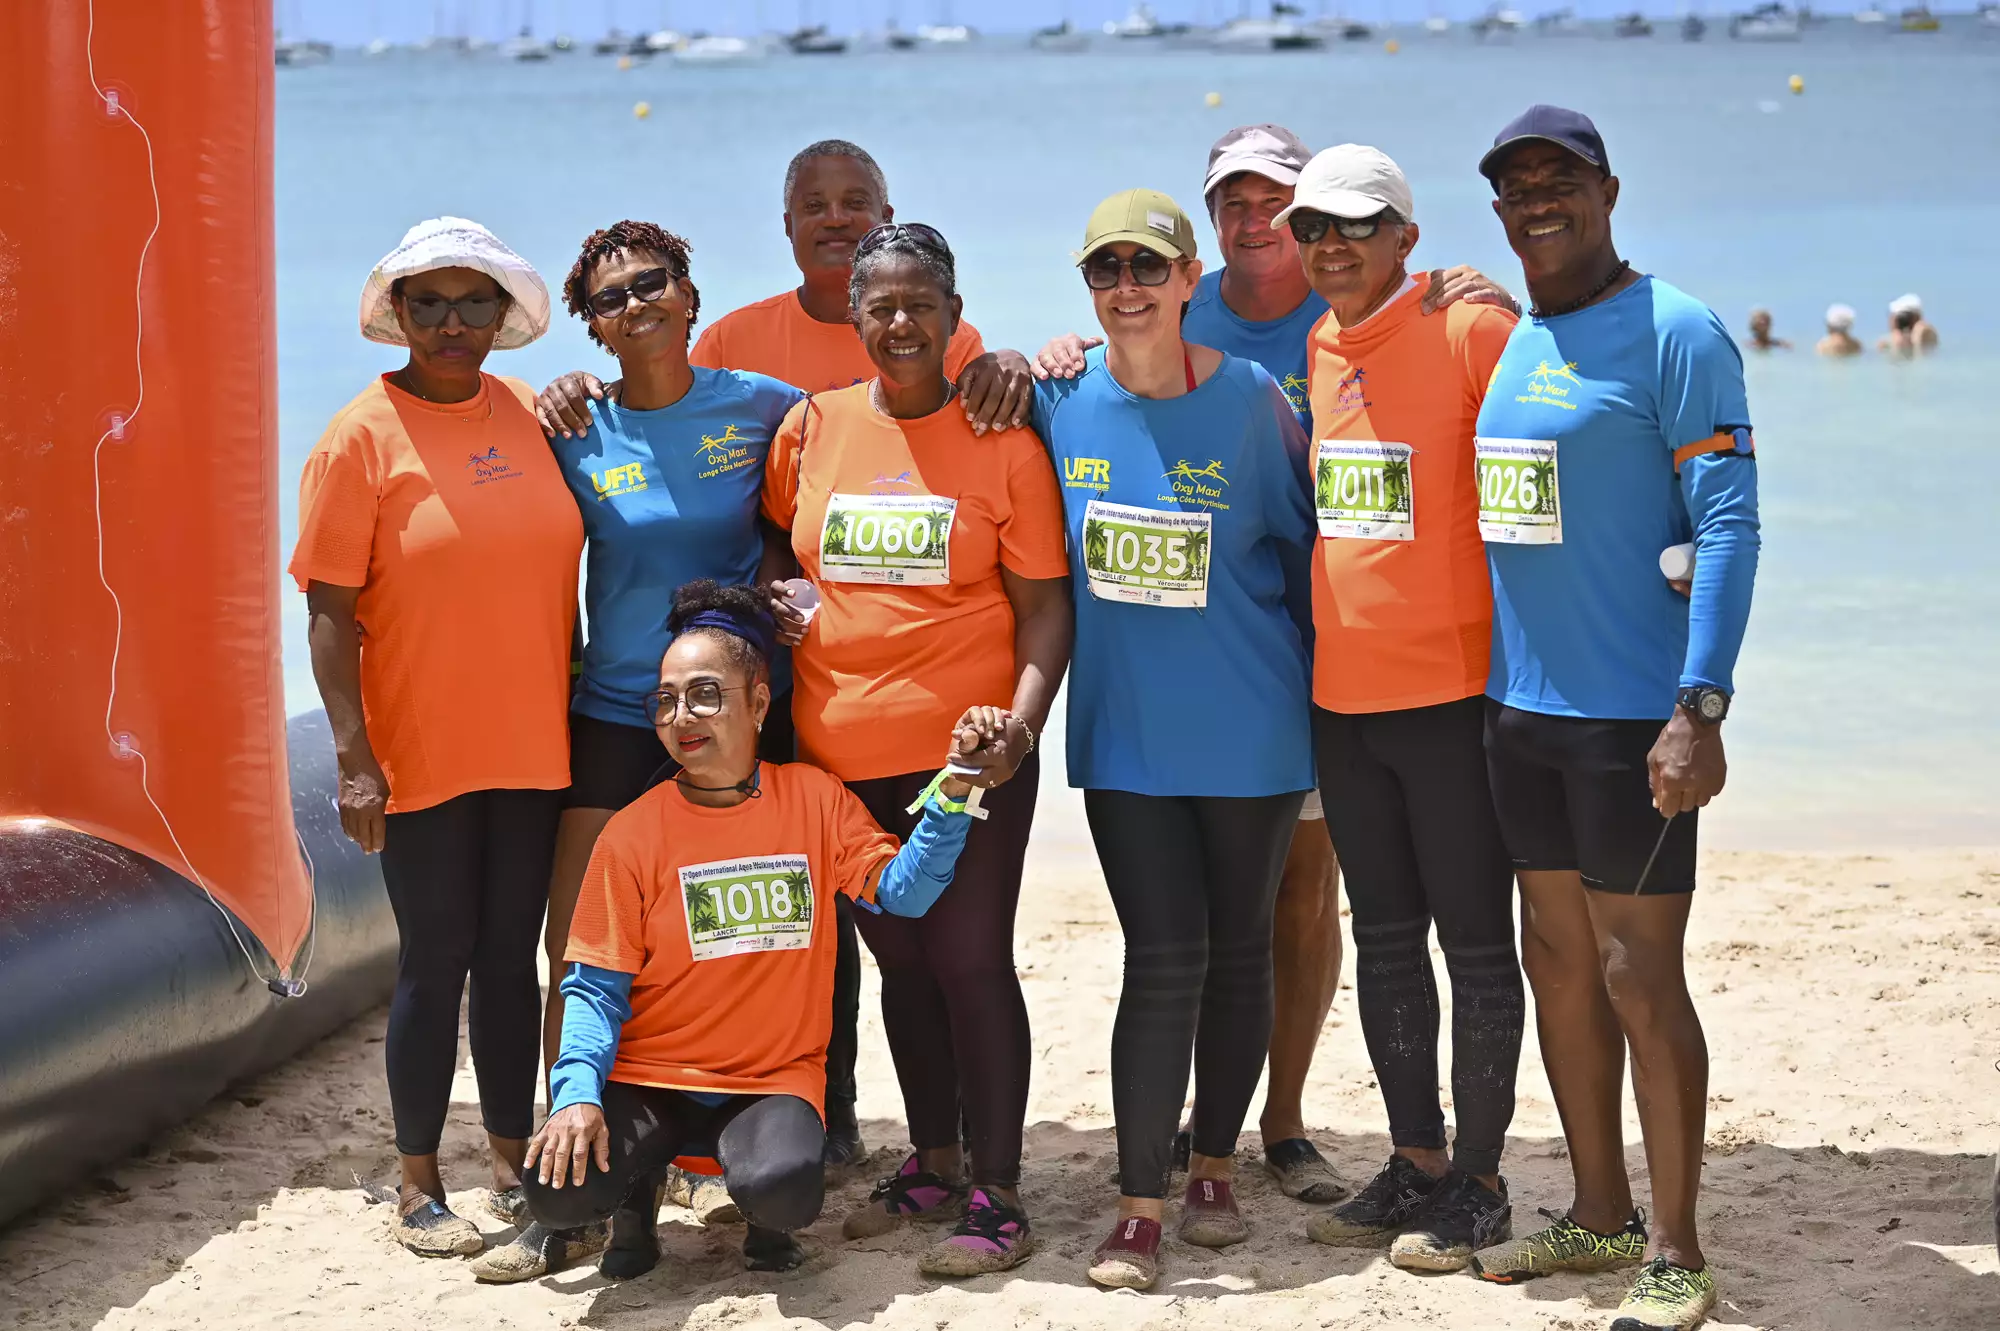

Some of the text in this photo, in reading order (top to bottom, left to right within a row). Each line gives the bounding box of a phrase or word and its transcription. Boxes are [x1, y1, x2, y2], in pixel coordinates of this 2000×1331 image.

[708, 445, 747, 465] Oxy Maxi
[476, 469, 492, 477] Oxy
[591, 462, 646, 493] UFR
[698, 468, 719, 479] Longe
[1064, 457, 1111, 483] UFR
[1172, 481, 1222, 498] Oxy Maxi
[1333, 465, 1385, 507] 1011
[1480, 465, 1537, 510] 1026
[1157, 494, 1178, 503] Longe
[1197, 497, 1230, 510] Martinique
[1094, 507, 1106, 516] Open
[1106, 508, 1137, 520] International
[1137, 514, 1150, 523] Aqua
[1150, 515, 1172, 526] Walking
[1173, 517, 1180, 526] de
[1181, 518, 1209, 528] Martinique
[843, 515, 931, 555] 1060
[1102, 528, 1188, 576] 1035
[1097, 571, 1127, 581] THUILLIEZ
[1157, 580, 1188, 588] Véronique
[688, 870, 702, 879] Open
[702, 864, 738, 876] International
[738, 863, 753, 872] Aqua
[752, 861, 775, 870] Walking
[774, 860, 782, 868] de
[782, 859, 807, 868] Martinique
[708, 879, 793, 925] 1018
[712, 927, 738, 938] LANCRY
